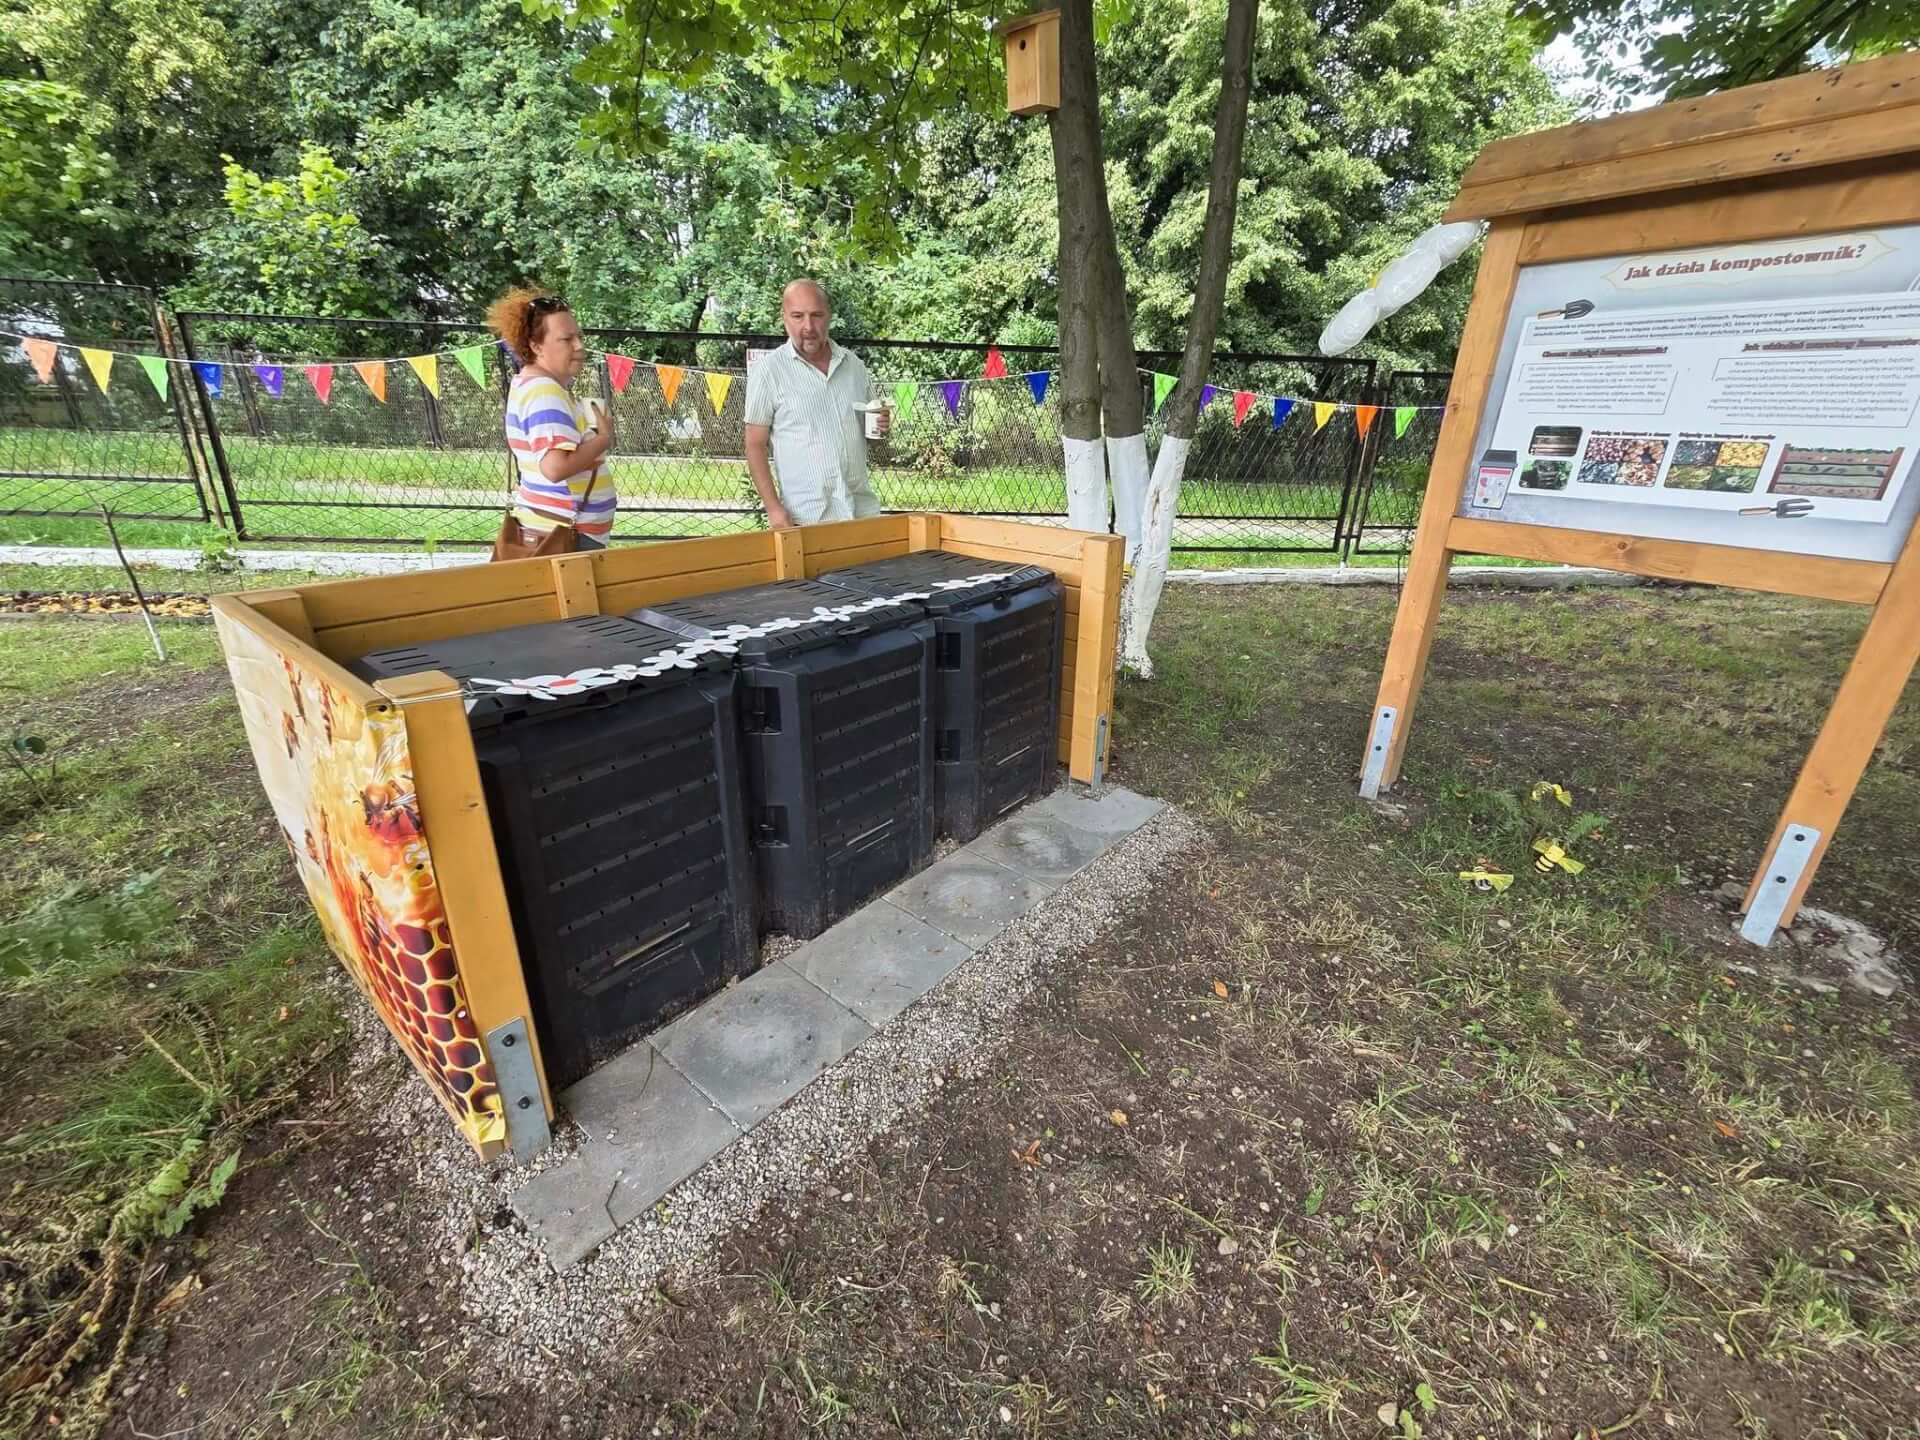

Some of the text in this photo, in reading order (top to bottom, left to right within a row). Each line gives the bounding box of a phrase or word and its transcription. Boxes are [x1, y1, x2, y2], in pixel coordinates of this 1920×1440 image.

[1624, 243, 1867, 281] Jak działa kompostownik?
